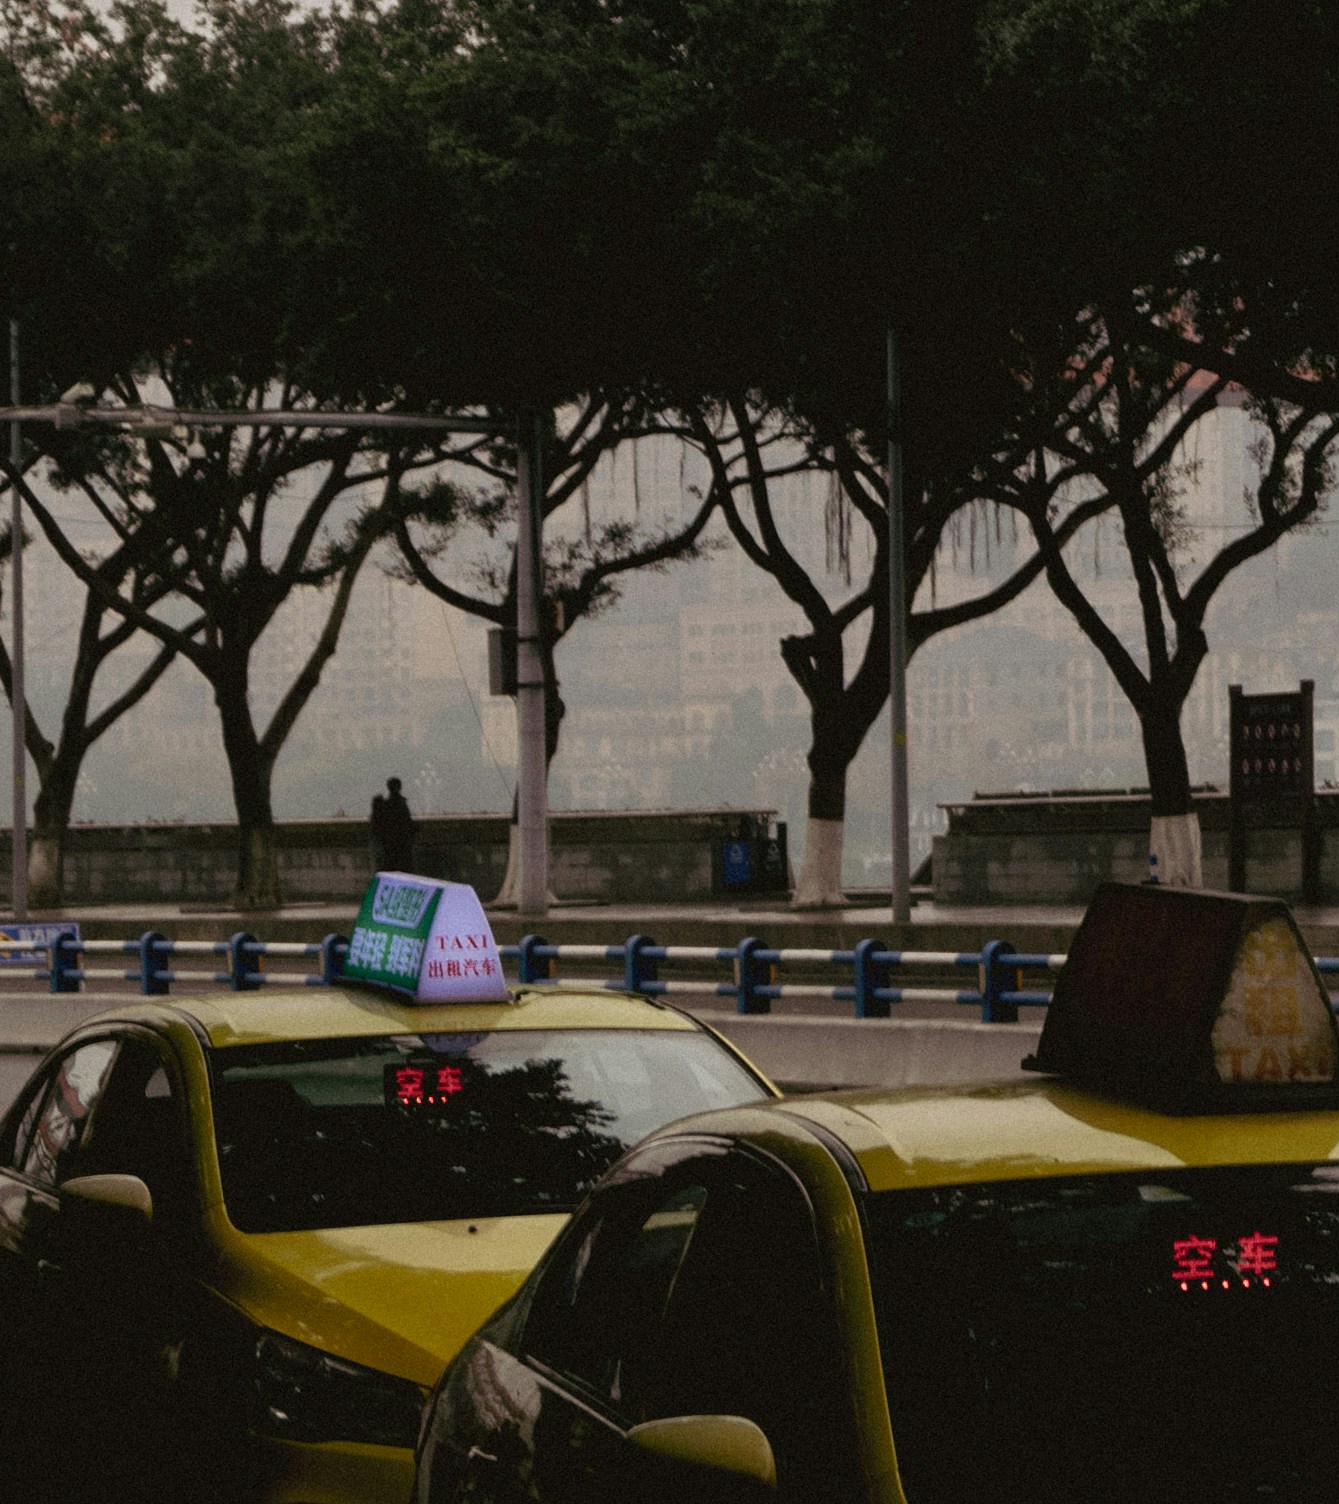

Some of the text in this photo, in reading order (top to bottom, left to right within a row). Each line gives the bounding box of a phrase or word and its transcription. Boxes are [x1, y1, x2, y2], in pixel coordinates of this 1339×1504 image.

[435, 934, 489, 951] TAXI
[428, 957, 497, 979] 出租汽车
[1217, 1044, 1331, 1082] TAXI
[396, 1066, 463, 1099] 空车
[1171, 1232, 1279, 1281] 空车
